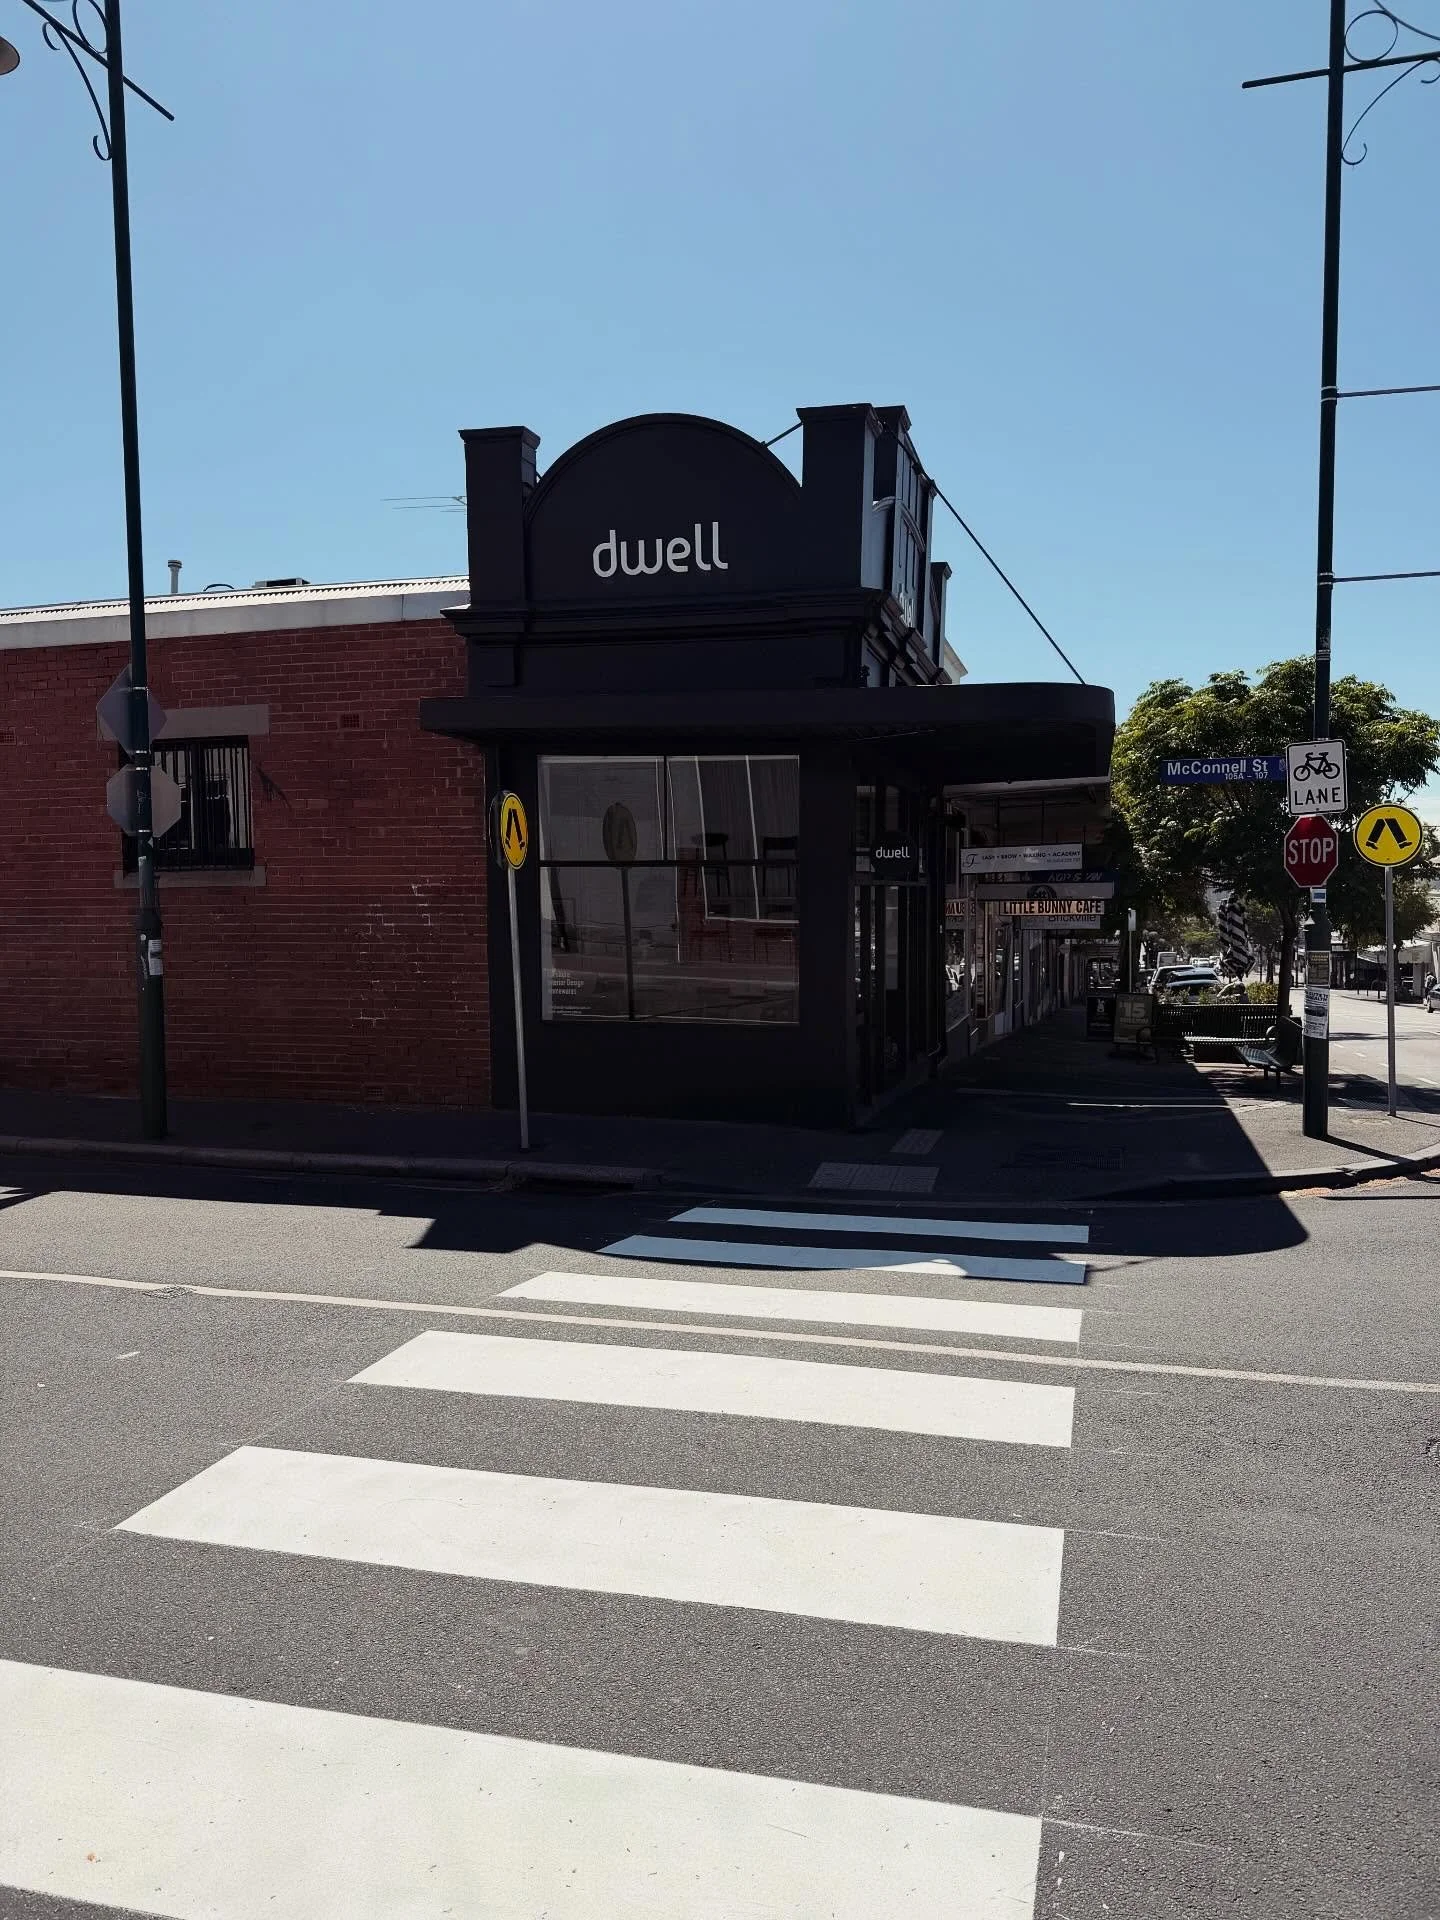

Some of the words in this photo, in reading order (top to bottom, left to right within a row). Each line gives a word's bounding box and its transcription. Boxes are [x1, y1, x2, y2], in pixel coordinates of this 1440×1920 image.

[592, 521, 728, 578] dwell
[1167, 759, 1247, 776] McConnell
[1252, 758, 1269, 773] St
[1224, 772, 1244, 781] 105A
[1255, 771, 1269, 780] 107
[1294, 787, 1341, 806] LANE
[875, 845, 911, 859] dwell
[1052, 850, 1081, 858] ACADEMY
[1287, 837, 1335, 865] STOP
[1003, 901, 1035, 914] LITTLE
[1038, 901, 1072, 914] BUNNY
[1075, 900, 1102, 913] CAFE
